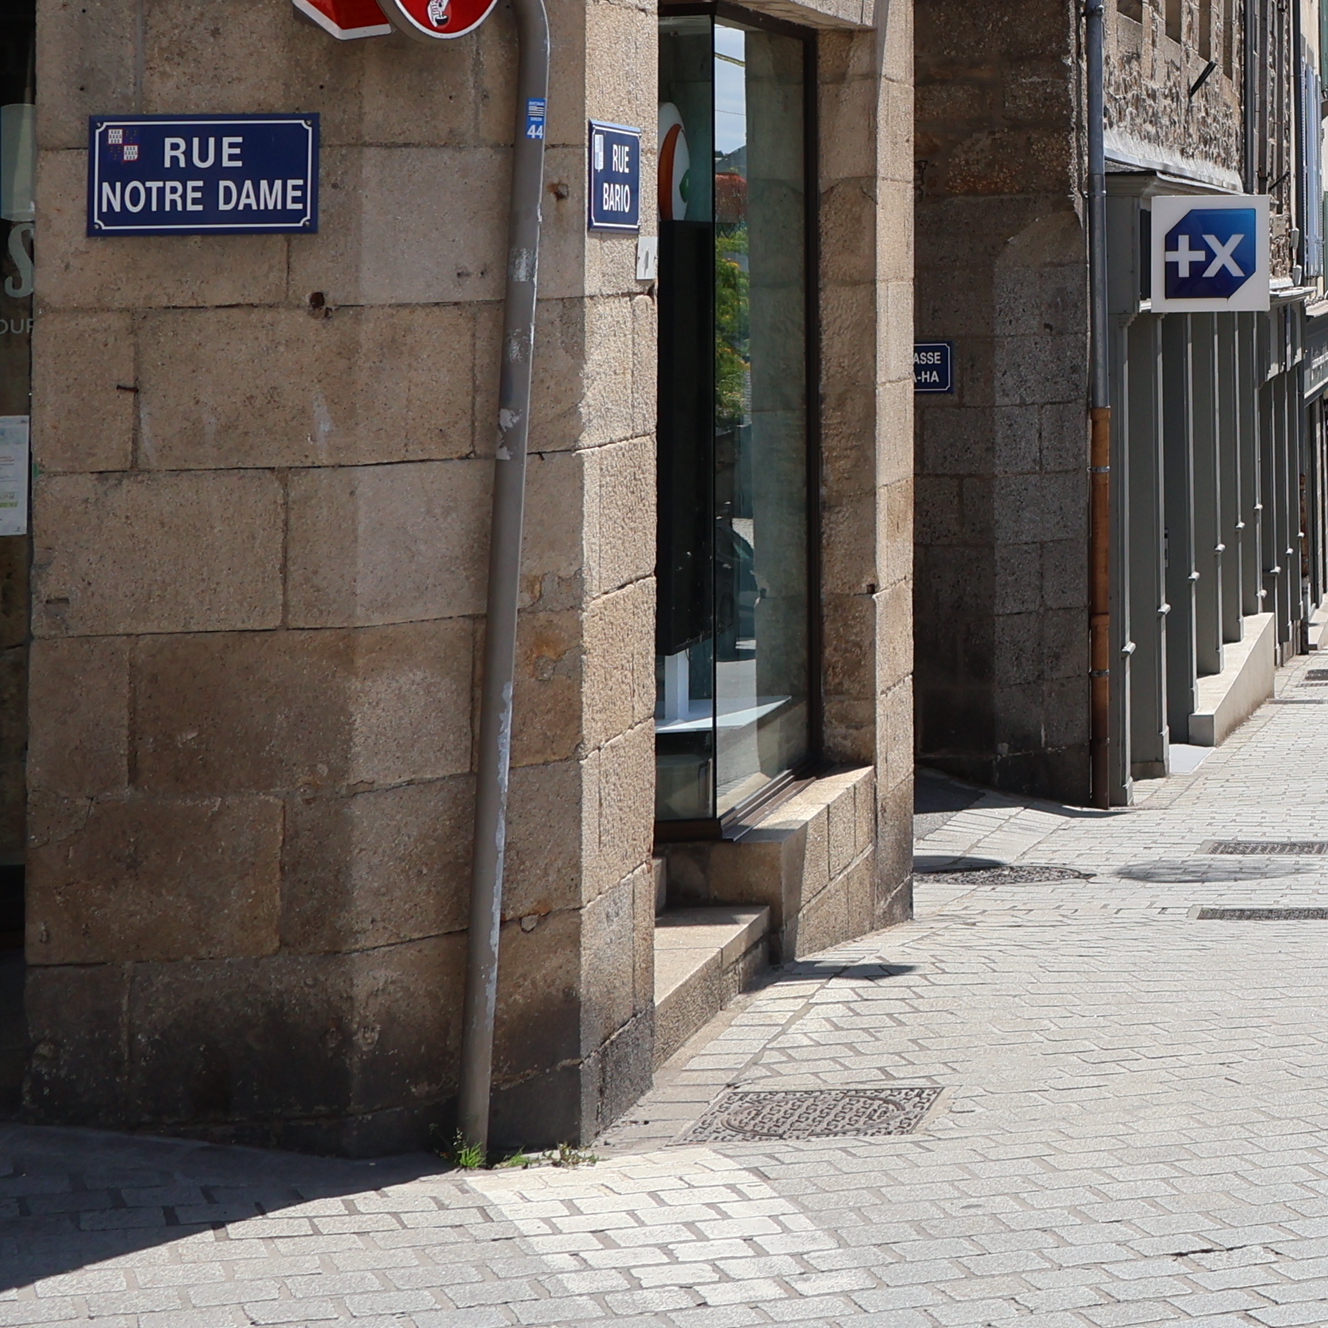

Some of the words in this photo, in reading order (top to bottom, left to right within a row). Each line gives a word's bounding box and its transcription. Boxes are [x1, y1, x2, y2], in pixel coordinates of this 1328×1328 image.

[527, 125, 543, 139] 44
[164, 136, 243, 168] RUE
[612, 144, 630, 173] RUE
[101, 180, 204, 213] NOTRE
[218, 179, 304, 210] DAME
[603, 182, 630, 213] BARIO
